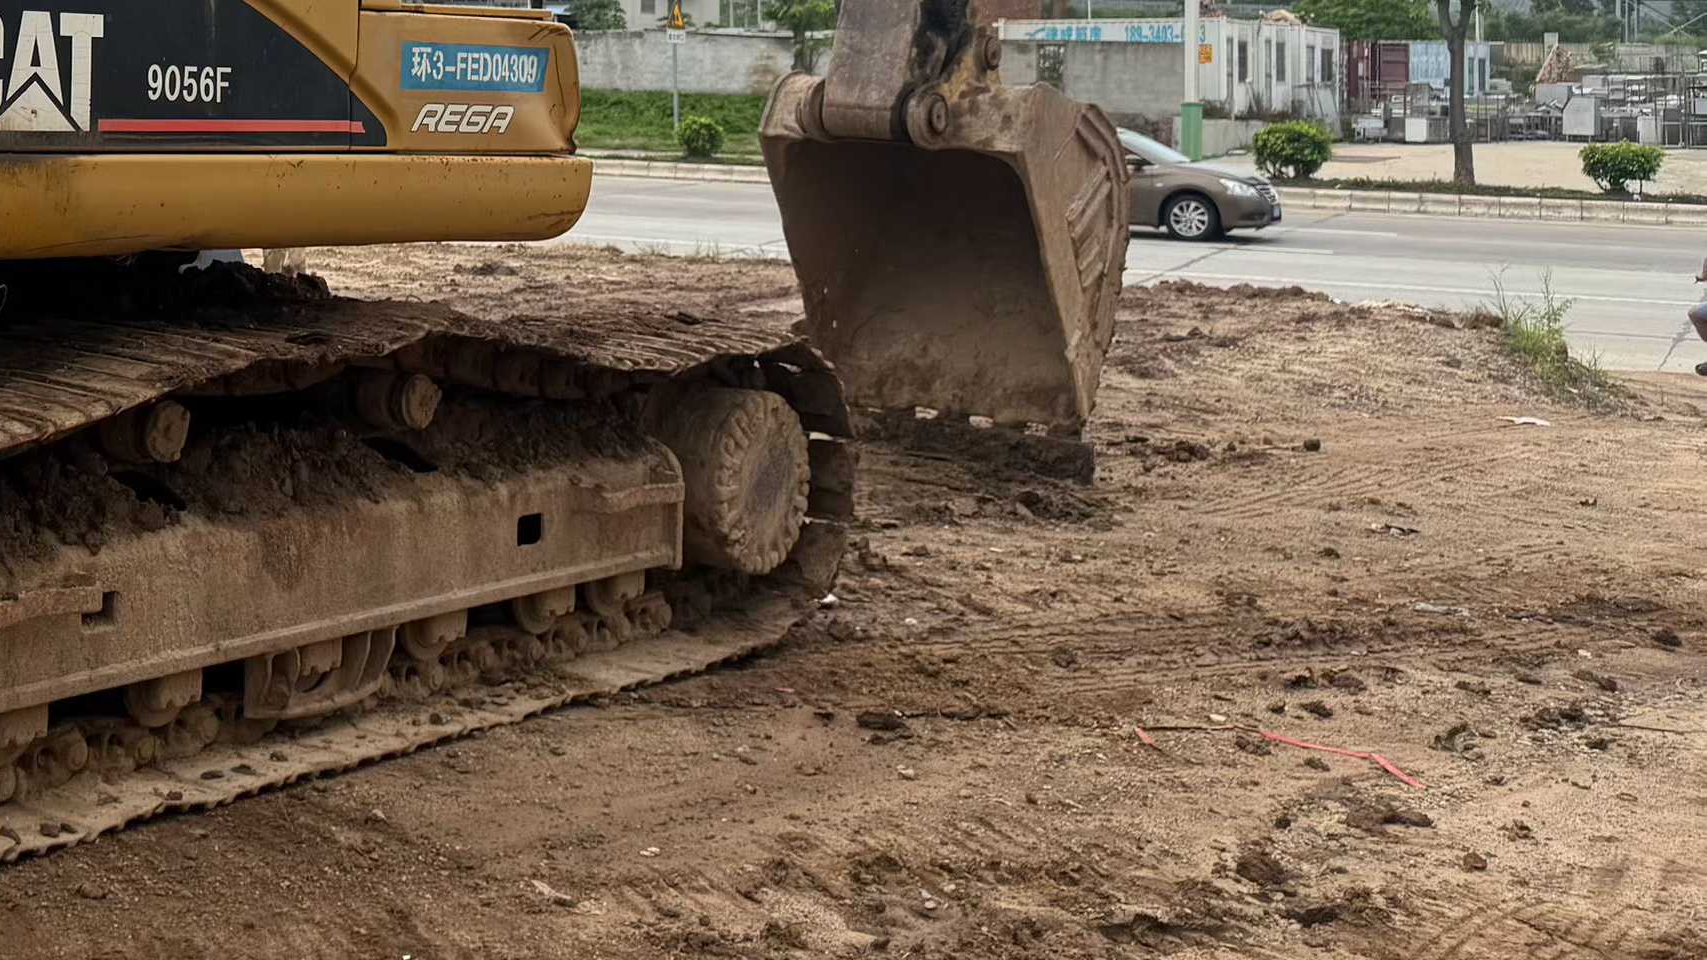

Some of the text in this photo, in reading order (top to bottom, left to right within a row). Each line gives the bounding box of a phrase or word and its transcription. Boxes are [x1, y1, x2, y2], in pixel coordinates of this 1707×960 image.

[411, 47, 539, 83] 环3-FED04309
[147, 64, 232, 103] 9056F
[410, 103, 516, 134] REGA
